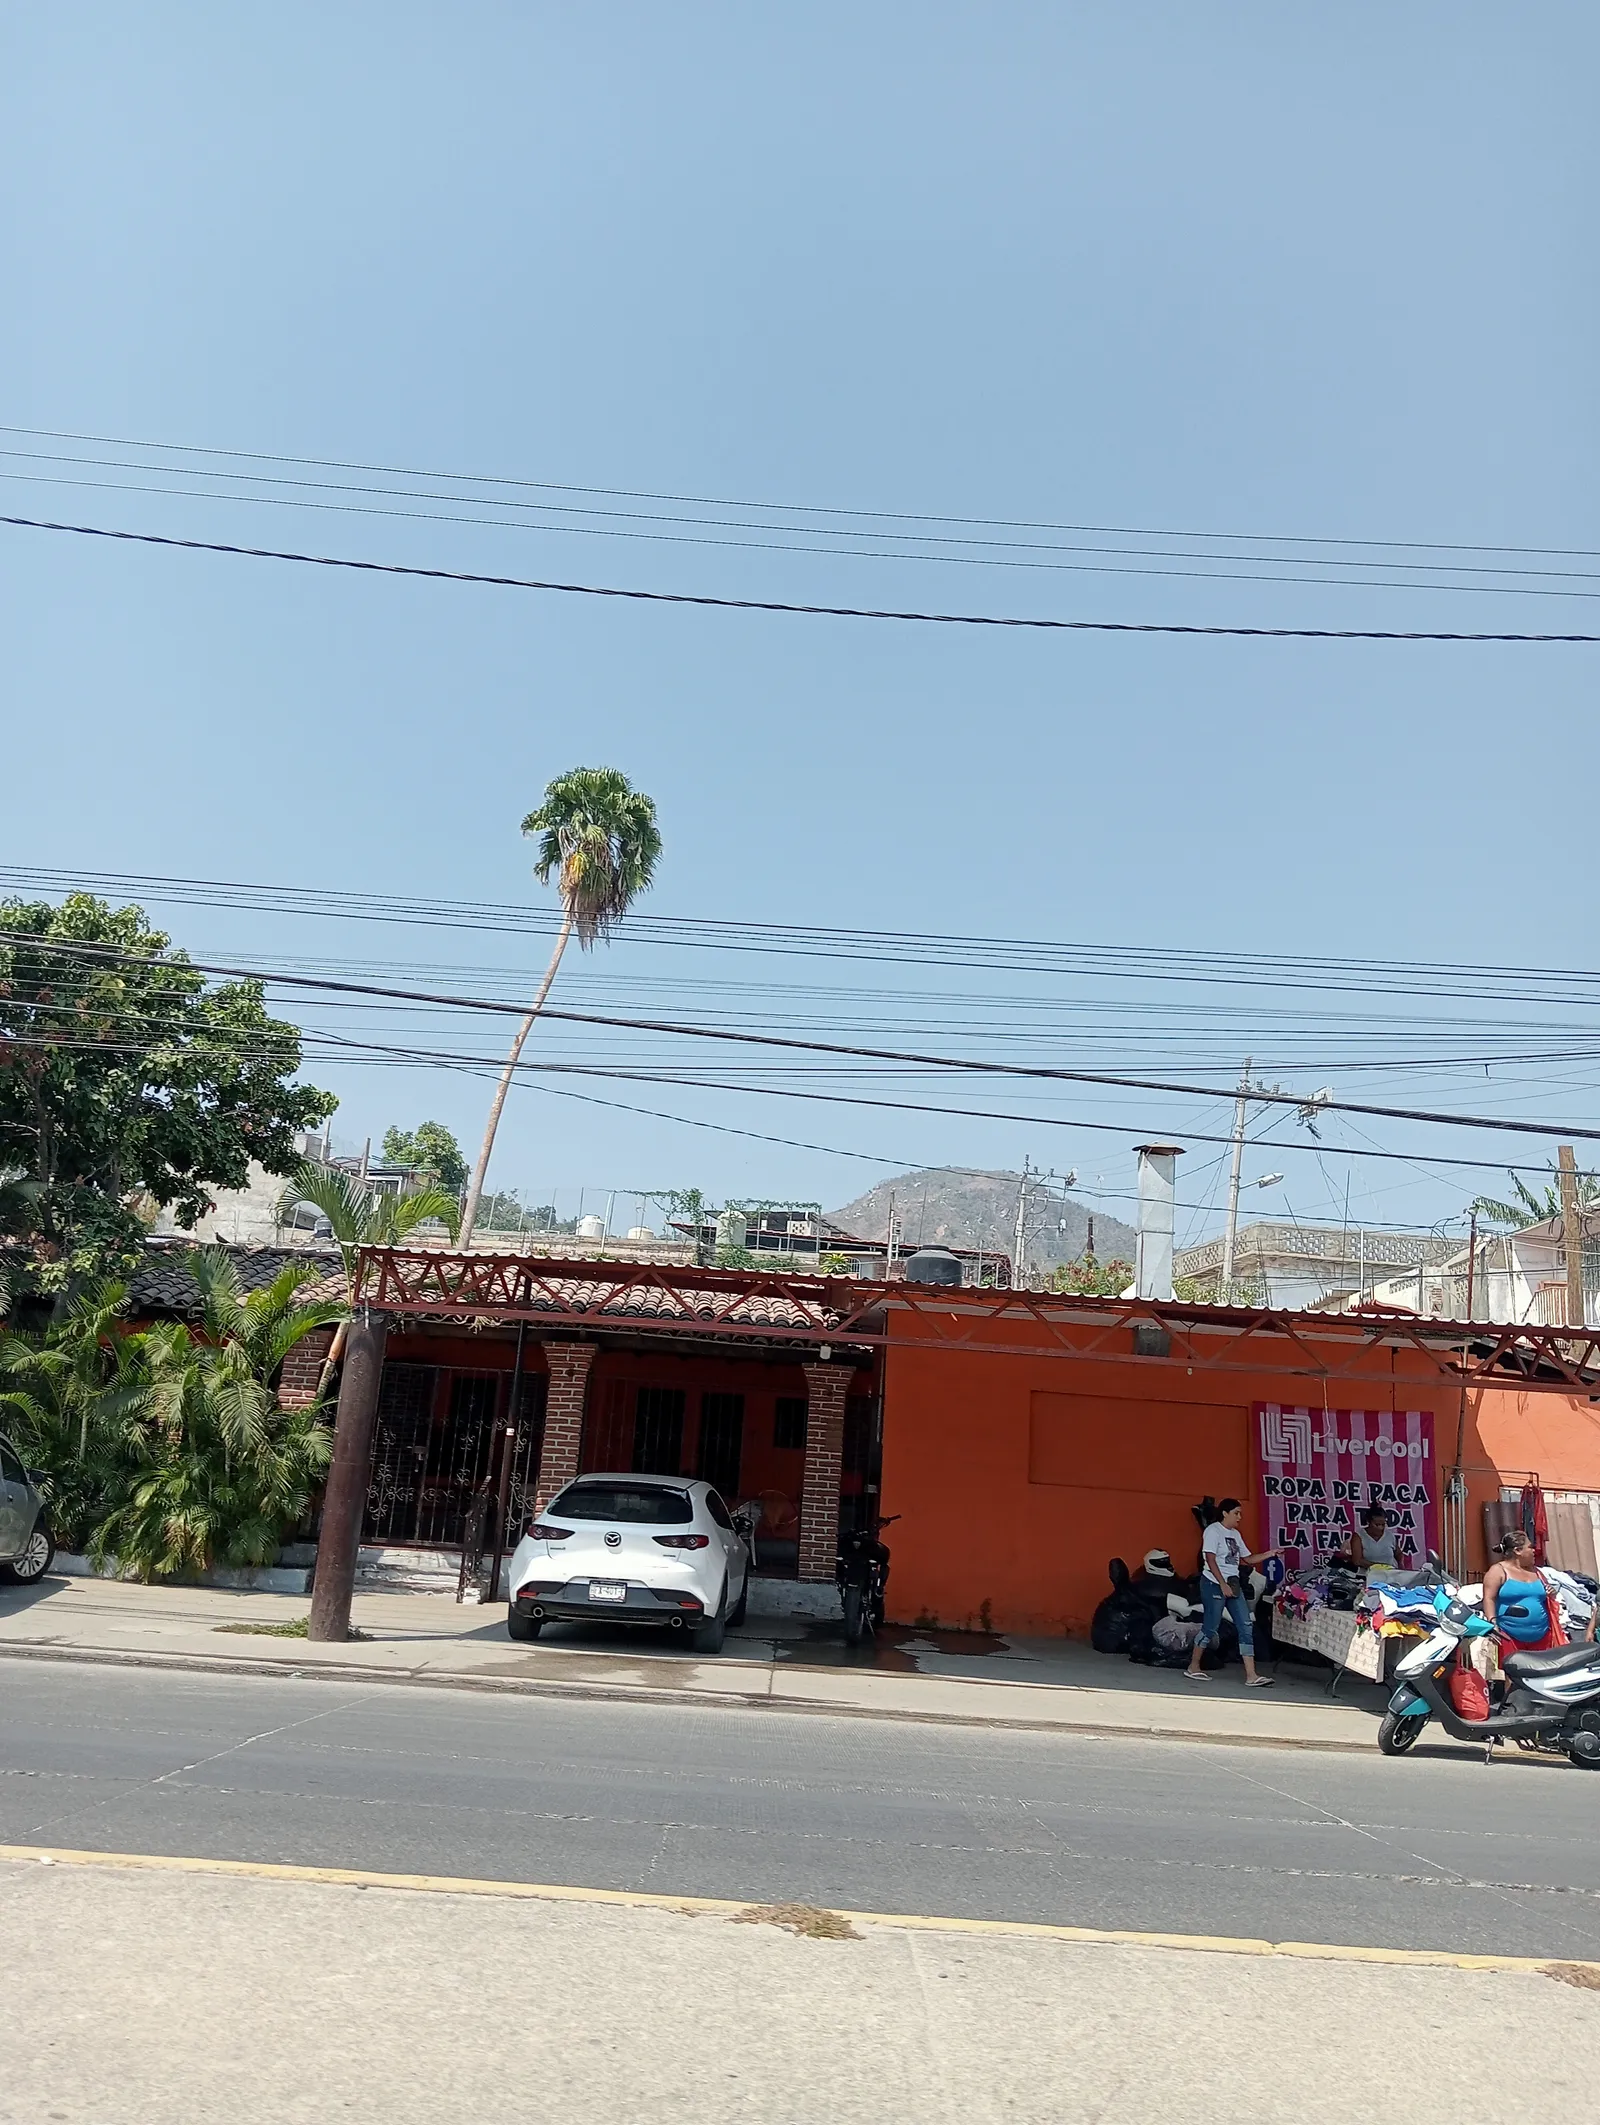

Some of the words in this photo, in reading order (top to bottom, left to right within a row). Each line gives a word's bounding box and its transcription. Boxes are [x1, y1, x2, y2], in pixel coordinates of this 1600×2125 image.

[1313, 1432, 1429, 1458] LiverCool
[1263, 1475, 1327, 1501] ROPA
[1332, 1479, 1363, 1502] DE
[1367, 1481, 1430, 1506] PACA
[1285, 1502, 1350, 1526] PARA
[1353, 1505, 1418, 1530] TDA
[1278, 1527, 1312, 1550] LA
